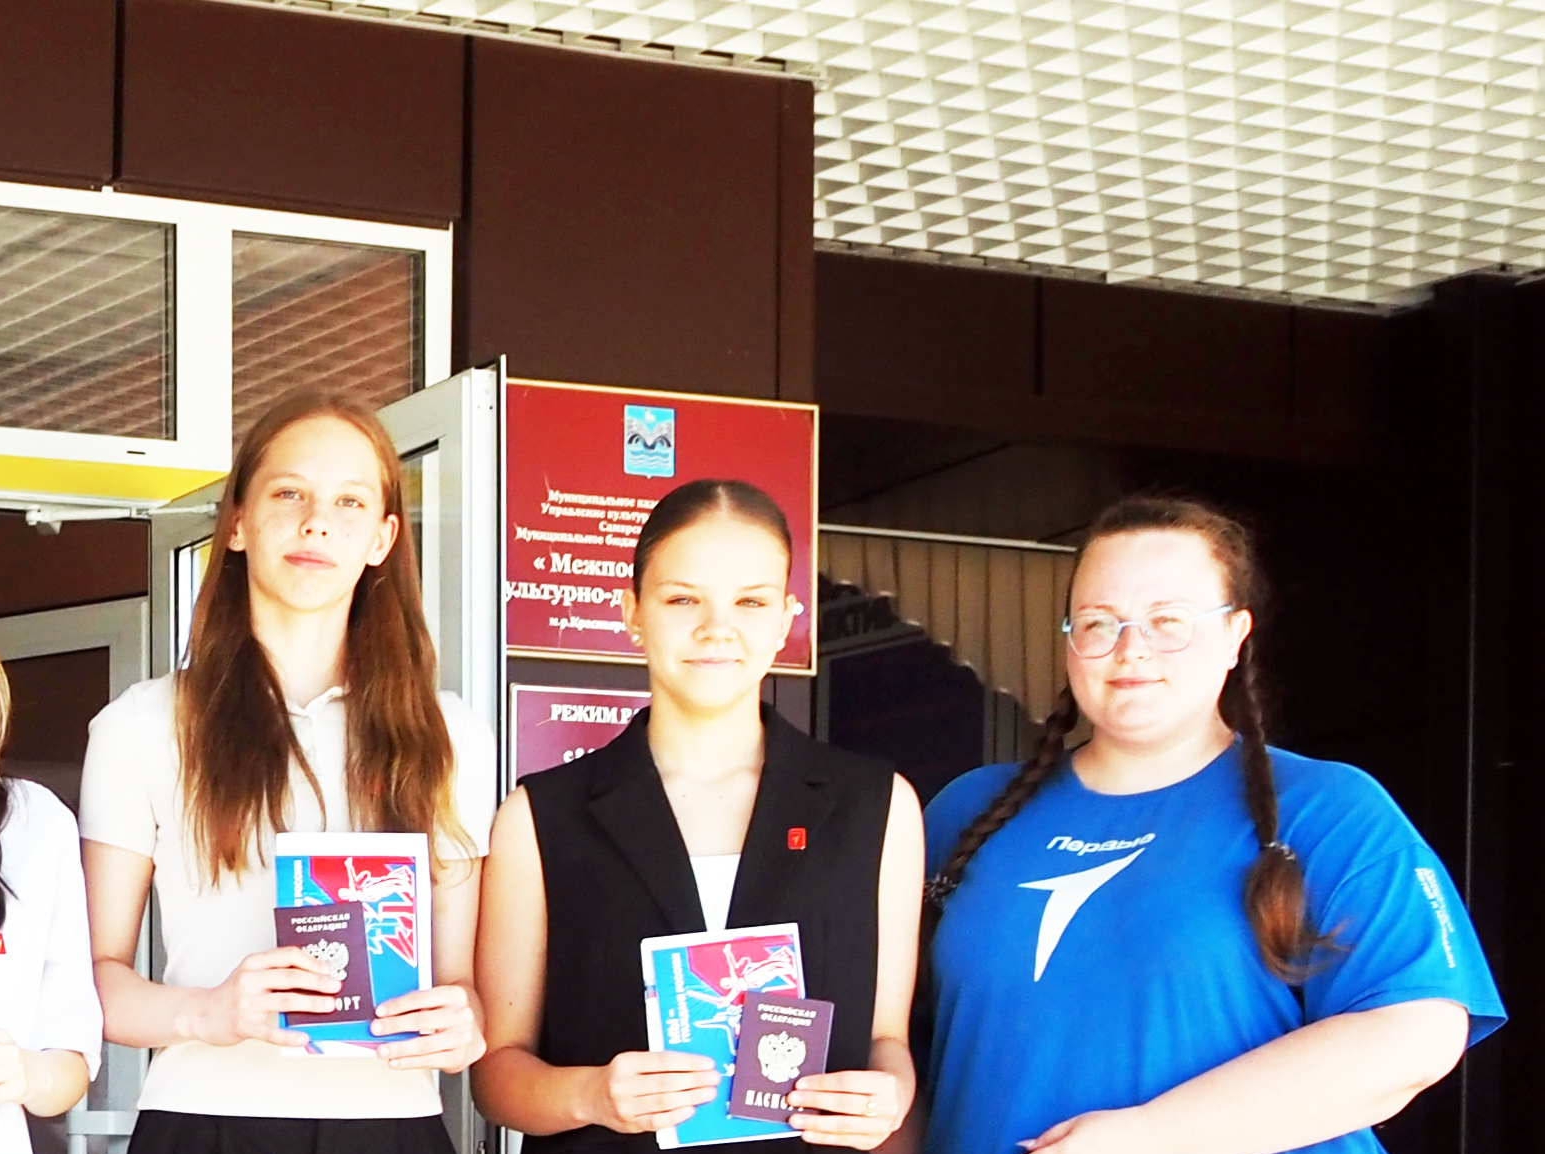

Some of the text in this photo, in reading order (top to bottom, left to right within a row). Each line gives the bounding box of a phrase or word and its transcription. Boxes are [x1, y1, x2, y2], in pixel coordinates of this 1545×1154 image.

[607, 510, 650, 522] культур
[505, 580, 624, 608] ультурно-д
[550, 703, 618, 724] РЕЖИМ
[1046, 833, 1156, 856] Первые
[291, 913, 350, 925] РОССИЙСКАЯ
[757, 1003, 817, 1018] РОССИЙСКАЯ
[666, 1018, 682, 1044] МЫ
